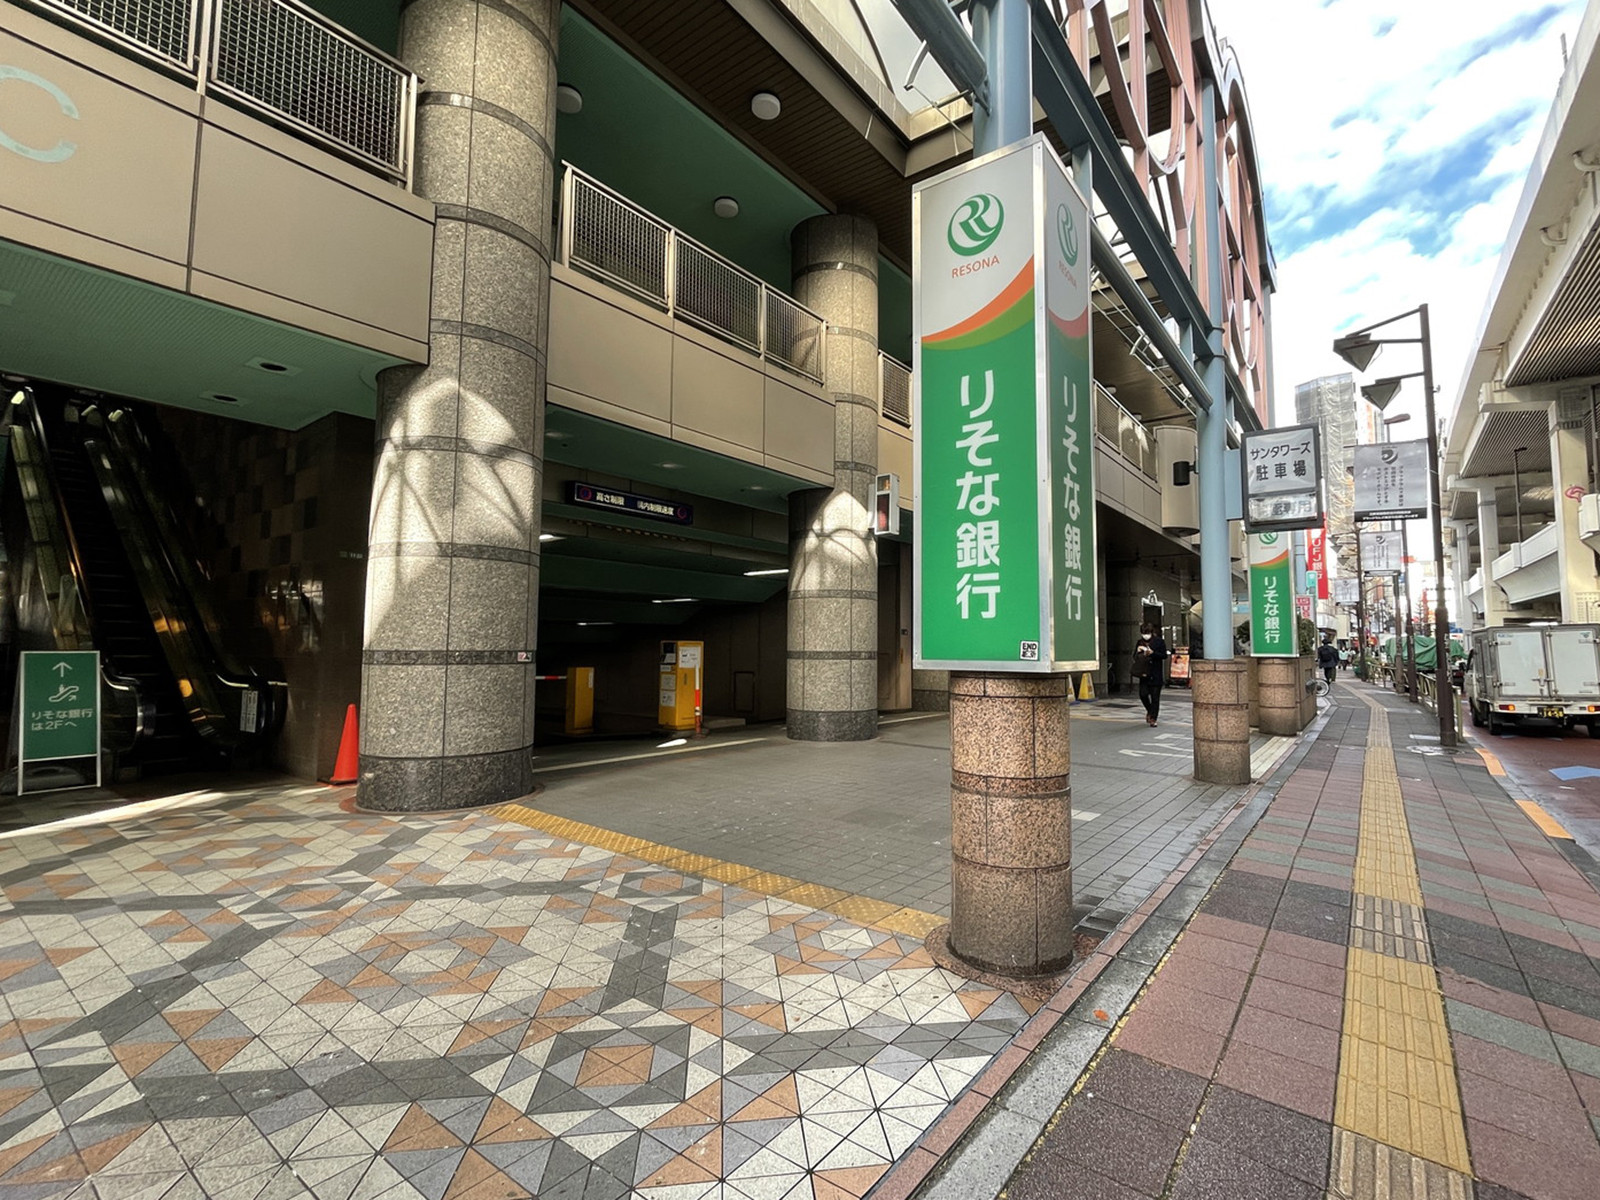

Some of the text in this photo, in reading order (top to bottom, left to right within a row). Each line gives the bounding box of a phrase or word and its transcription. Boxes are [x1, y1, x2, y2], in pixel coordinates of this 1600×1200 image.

[951, 255, 1000, 278] RESONA
[1250, 441, 1311, 461] サンタワーズ
[1255, 460, 1307, 481] 駐車場
[596, 492, 625, 506] 高さ制限
[955, 369, 1001, 620] りそな銀行
[1062, 375, 1083, 621] りそな銀行
[1263, 575, 1280, 644] りそな銀行
[31, 708, 93, 720] りそな銀行
[31, 720, 78, 731] は2Fへ
